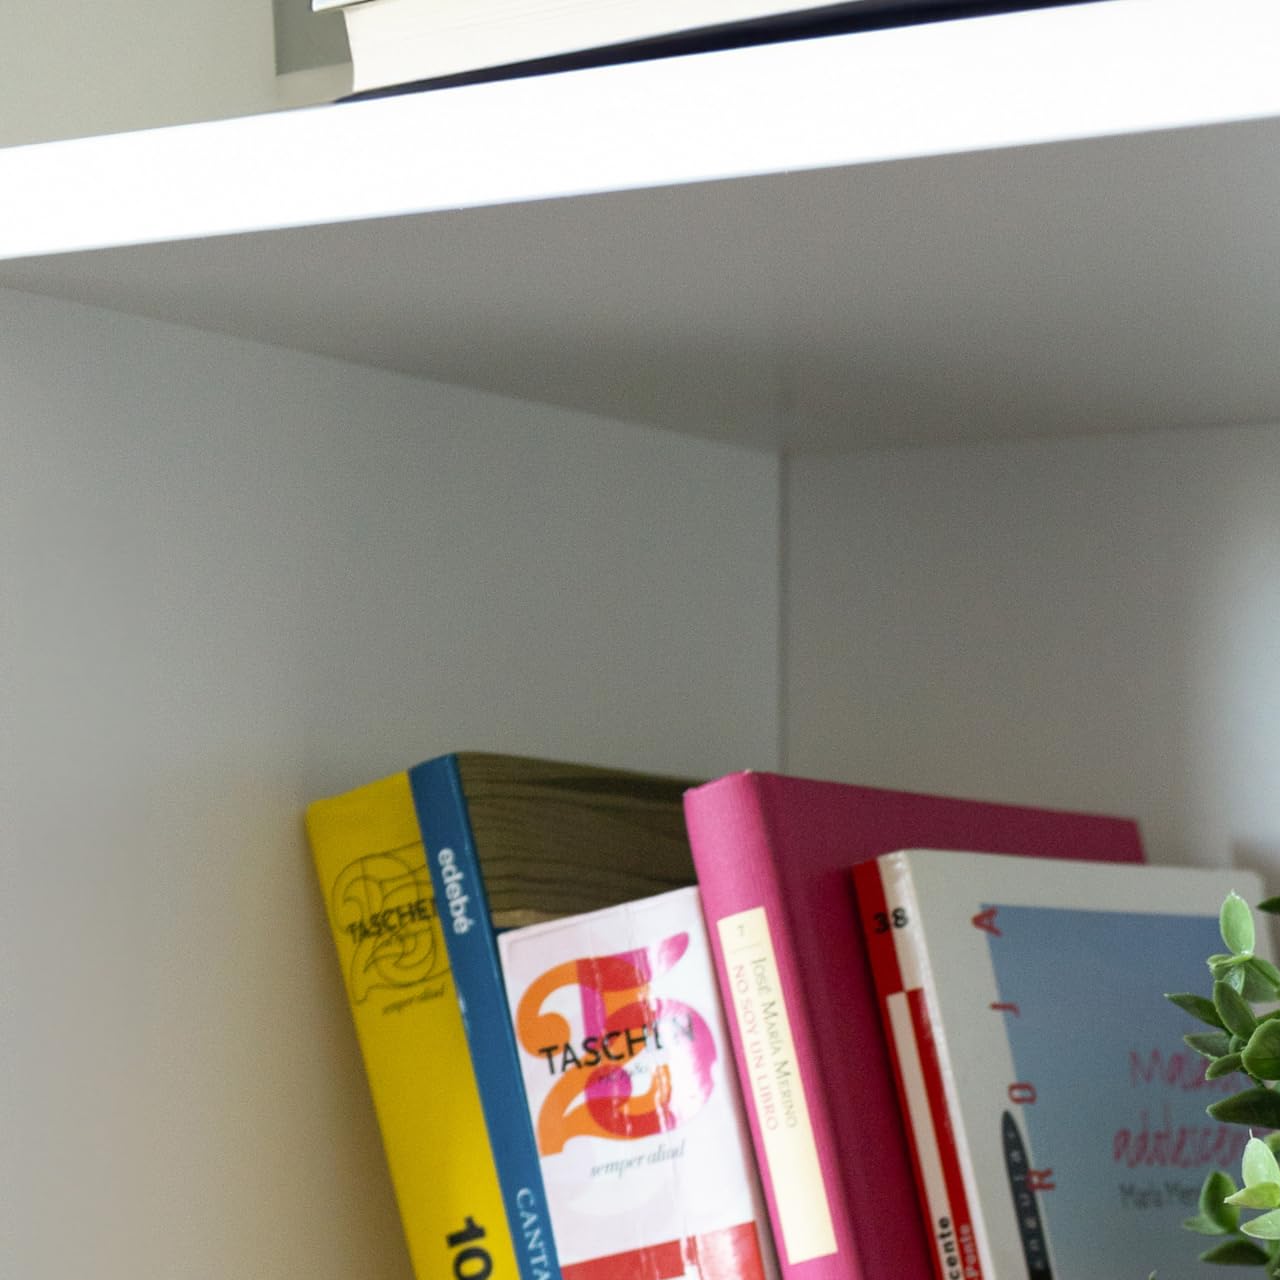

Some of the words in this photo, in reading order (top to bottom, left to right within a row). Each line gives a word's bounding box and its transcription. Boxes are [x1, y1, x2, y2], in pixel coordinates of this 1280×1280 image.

[438, 848, 474, 934] edebé
[873, 907, 909, 934] 38
[732, 963, 749, 993] NO
[740, 997, 758, 1034] SOY
[750, 1040, 766, 1067] UN
[756, 1074, 779, 1131] LIBRO
